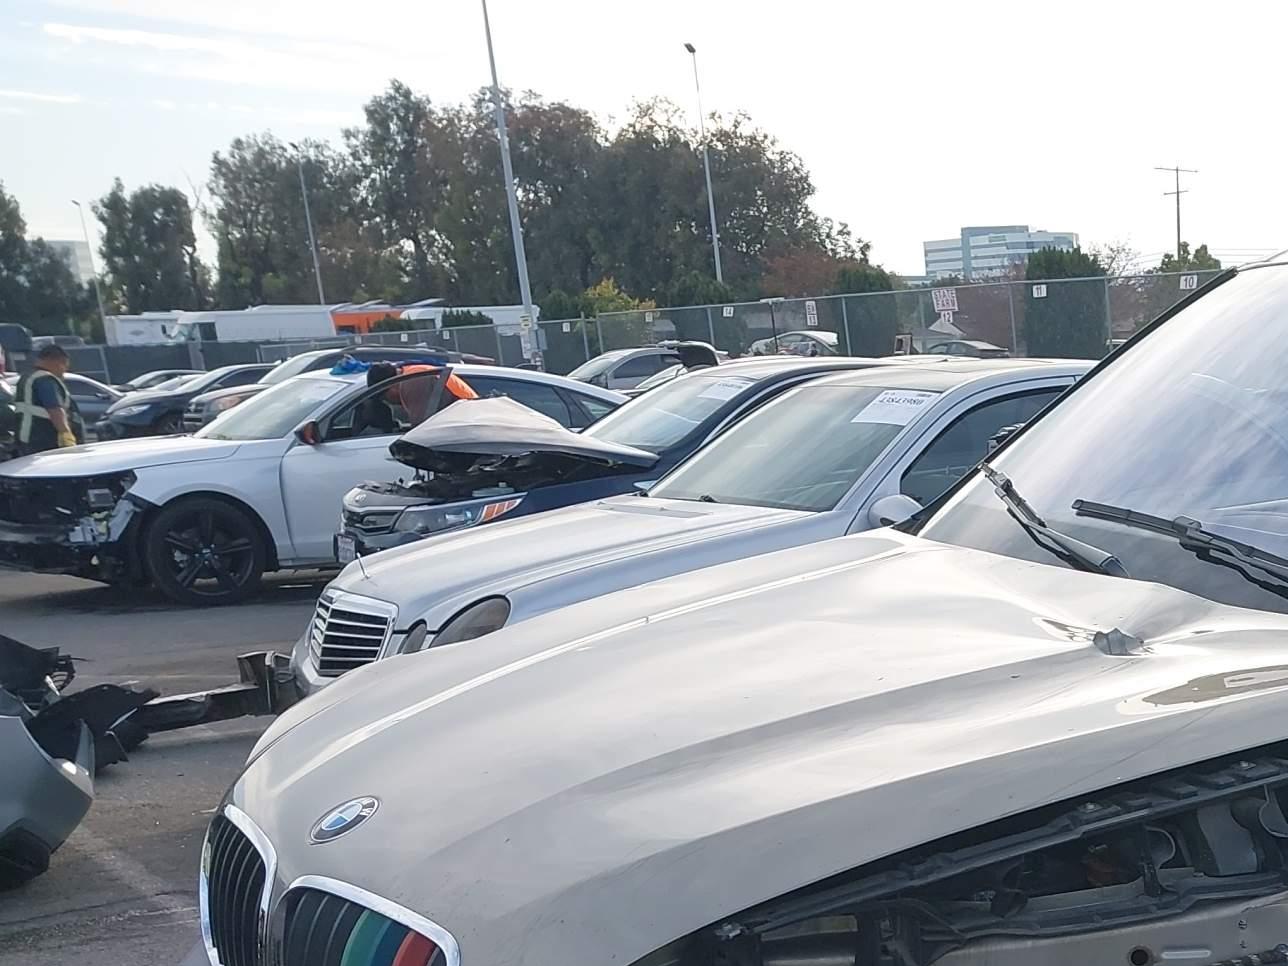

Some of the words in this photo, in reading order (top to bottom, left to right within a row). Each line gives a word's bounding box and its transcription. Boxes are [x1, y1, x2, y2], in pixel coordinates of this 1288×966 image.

[1184, 276, 1194, 288] 10
[934, 288, 955, 298] STATE
[1035, 285, 1042, 296] 11
[936, 298, 956, 309] FARM
[943, 312, 951, 322] 12
